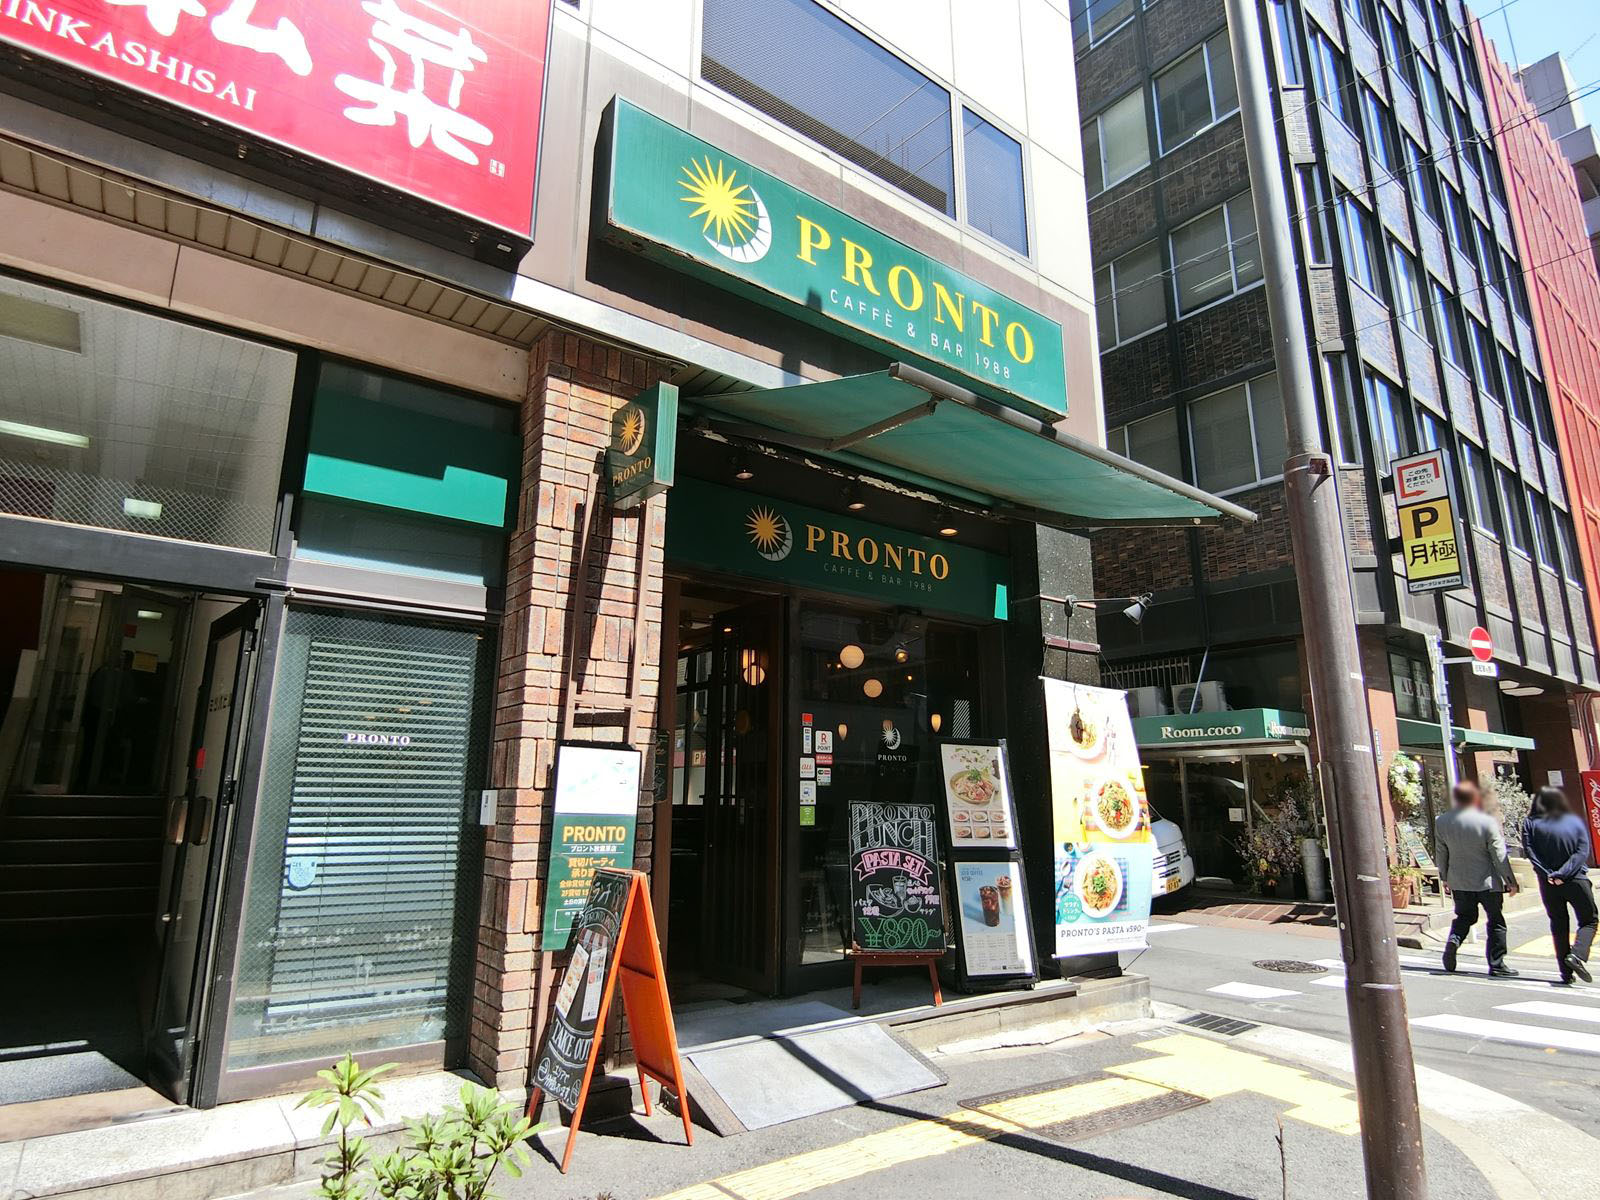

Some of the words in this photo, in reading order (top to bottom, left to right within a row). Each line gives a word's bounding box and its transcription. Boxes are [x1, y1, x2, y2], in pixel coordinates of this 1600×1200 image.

[795, 214, 1036, 366] PRONTO
[906, 322, 917, 338] &
[930, 333, 964, 358] BAR
[975, 352, 1012, 380] 1988
[611, 457, 652, 487] PRONTO
[1406, 473, 1432, 483] おまわり
[1408, 468, 1428, 477] この先
[1407, 479, 1433, 488] ください
[1411, 507, 1439, 539] P
[805, 524, 949, 580] PRONTO
[1409, 539, 1457, 567] 月極
[881, 575, 901, 586] BAR
[909, 580, 933, 592] 1988
[346, 732, 411, 746] PRONTO
[821, 733, 827, 743] R
[1160, 725, 1242, 739] Room.coco
[877, 754, 907, 762] PRONTO
[851, 804, 931, 837] PRONTO
[563, 826, 626, 843] PRONTO
[852, 820, 935, 862] LUNCH
[864, 851, 901, 869] PASTA
[902, 855, 924, 874] SET
[1060, 927, 1101, 938] PRONTO'S
[1102, 925, 1125, 935] PASTA
[552, 1017, 576, 1057] TAKE
